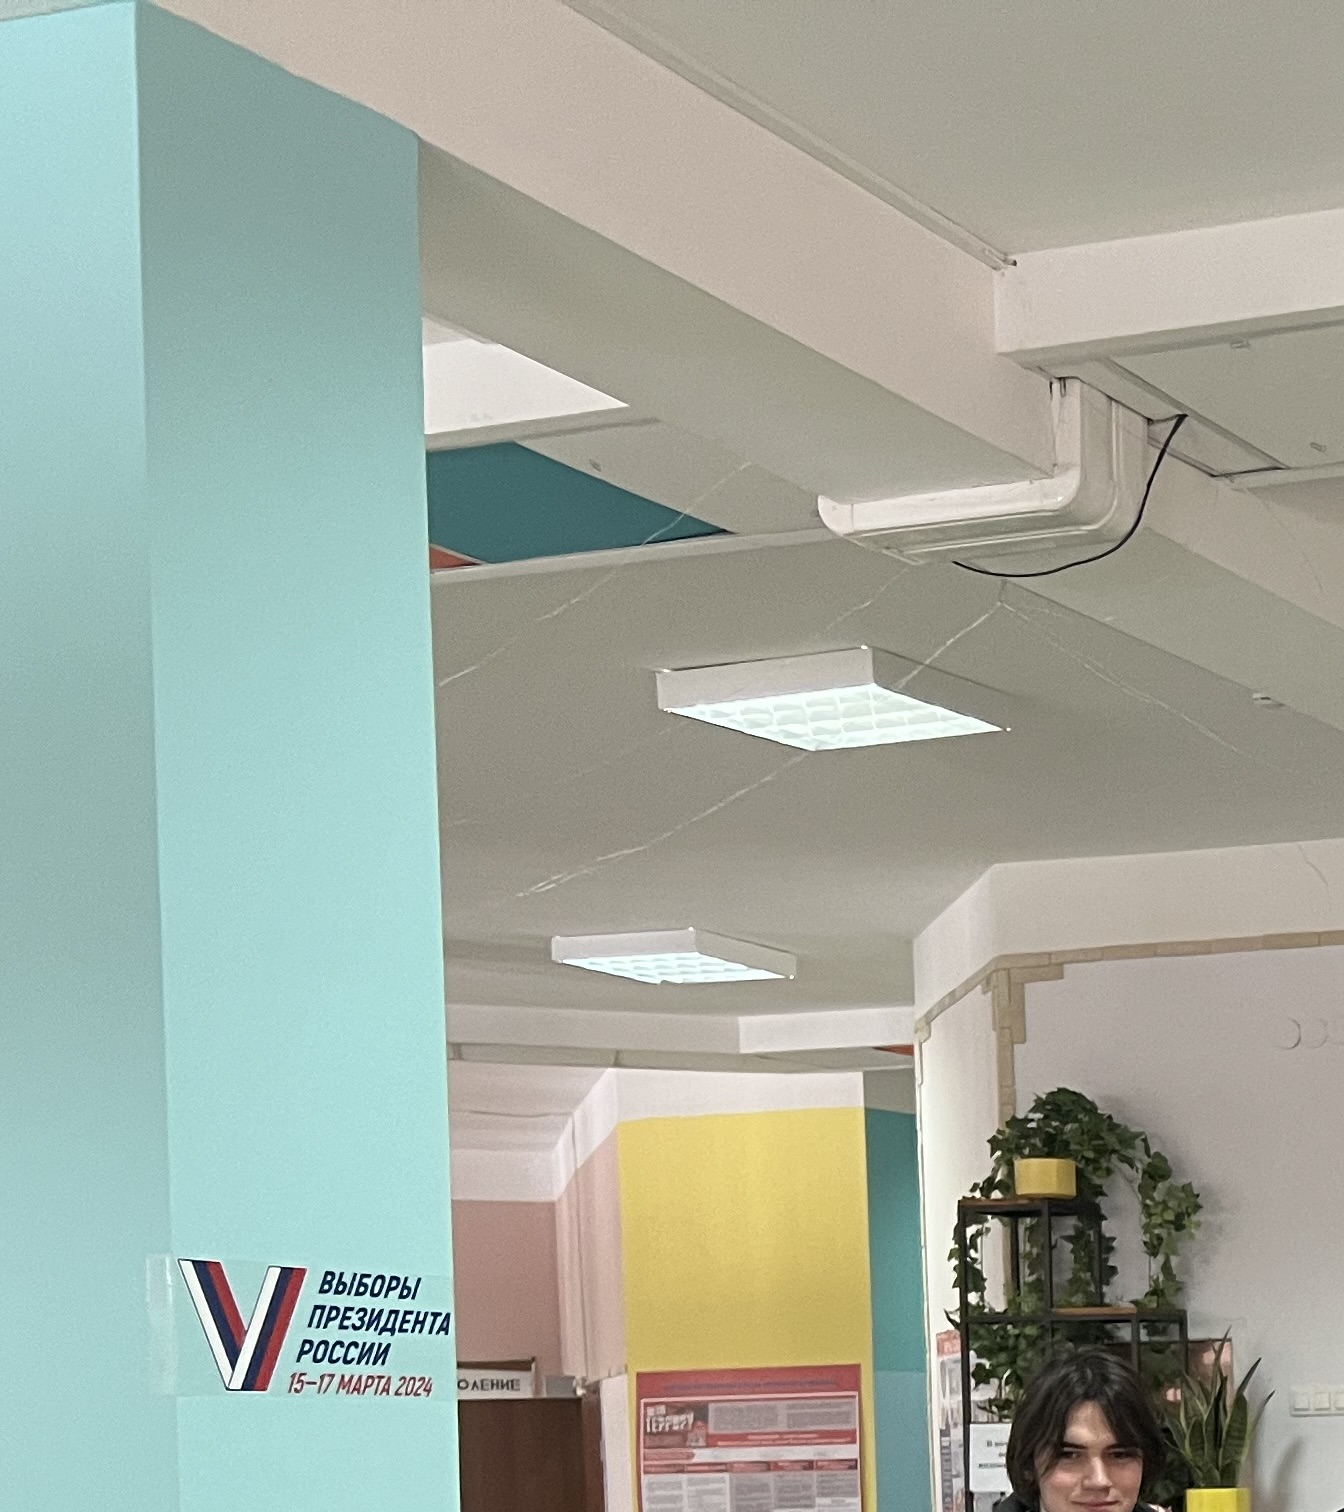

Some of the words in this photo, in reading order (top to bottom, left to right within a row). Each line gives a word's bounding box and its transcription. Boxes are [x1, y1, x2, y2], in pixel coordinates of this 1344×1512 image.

[318, 1270, 422, 1301] ВЫБОРЫ
[307, 1304, 451, 1337] ПРЕЗИДЕНТА
[296, 1339, 392, 1366] РОССИИ
[335, 1374, 391, 1396] МАРТА
[394, 1376, 433, 1398] 2024
[457, 1378, 521, 1391] ОЛЕНИЕ
